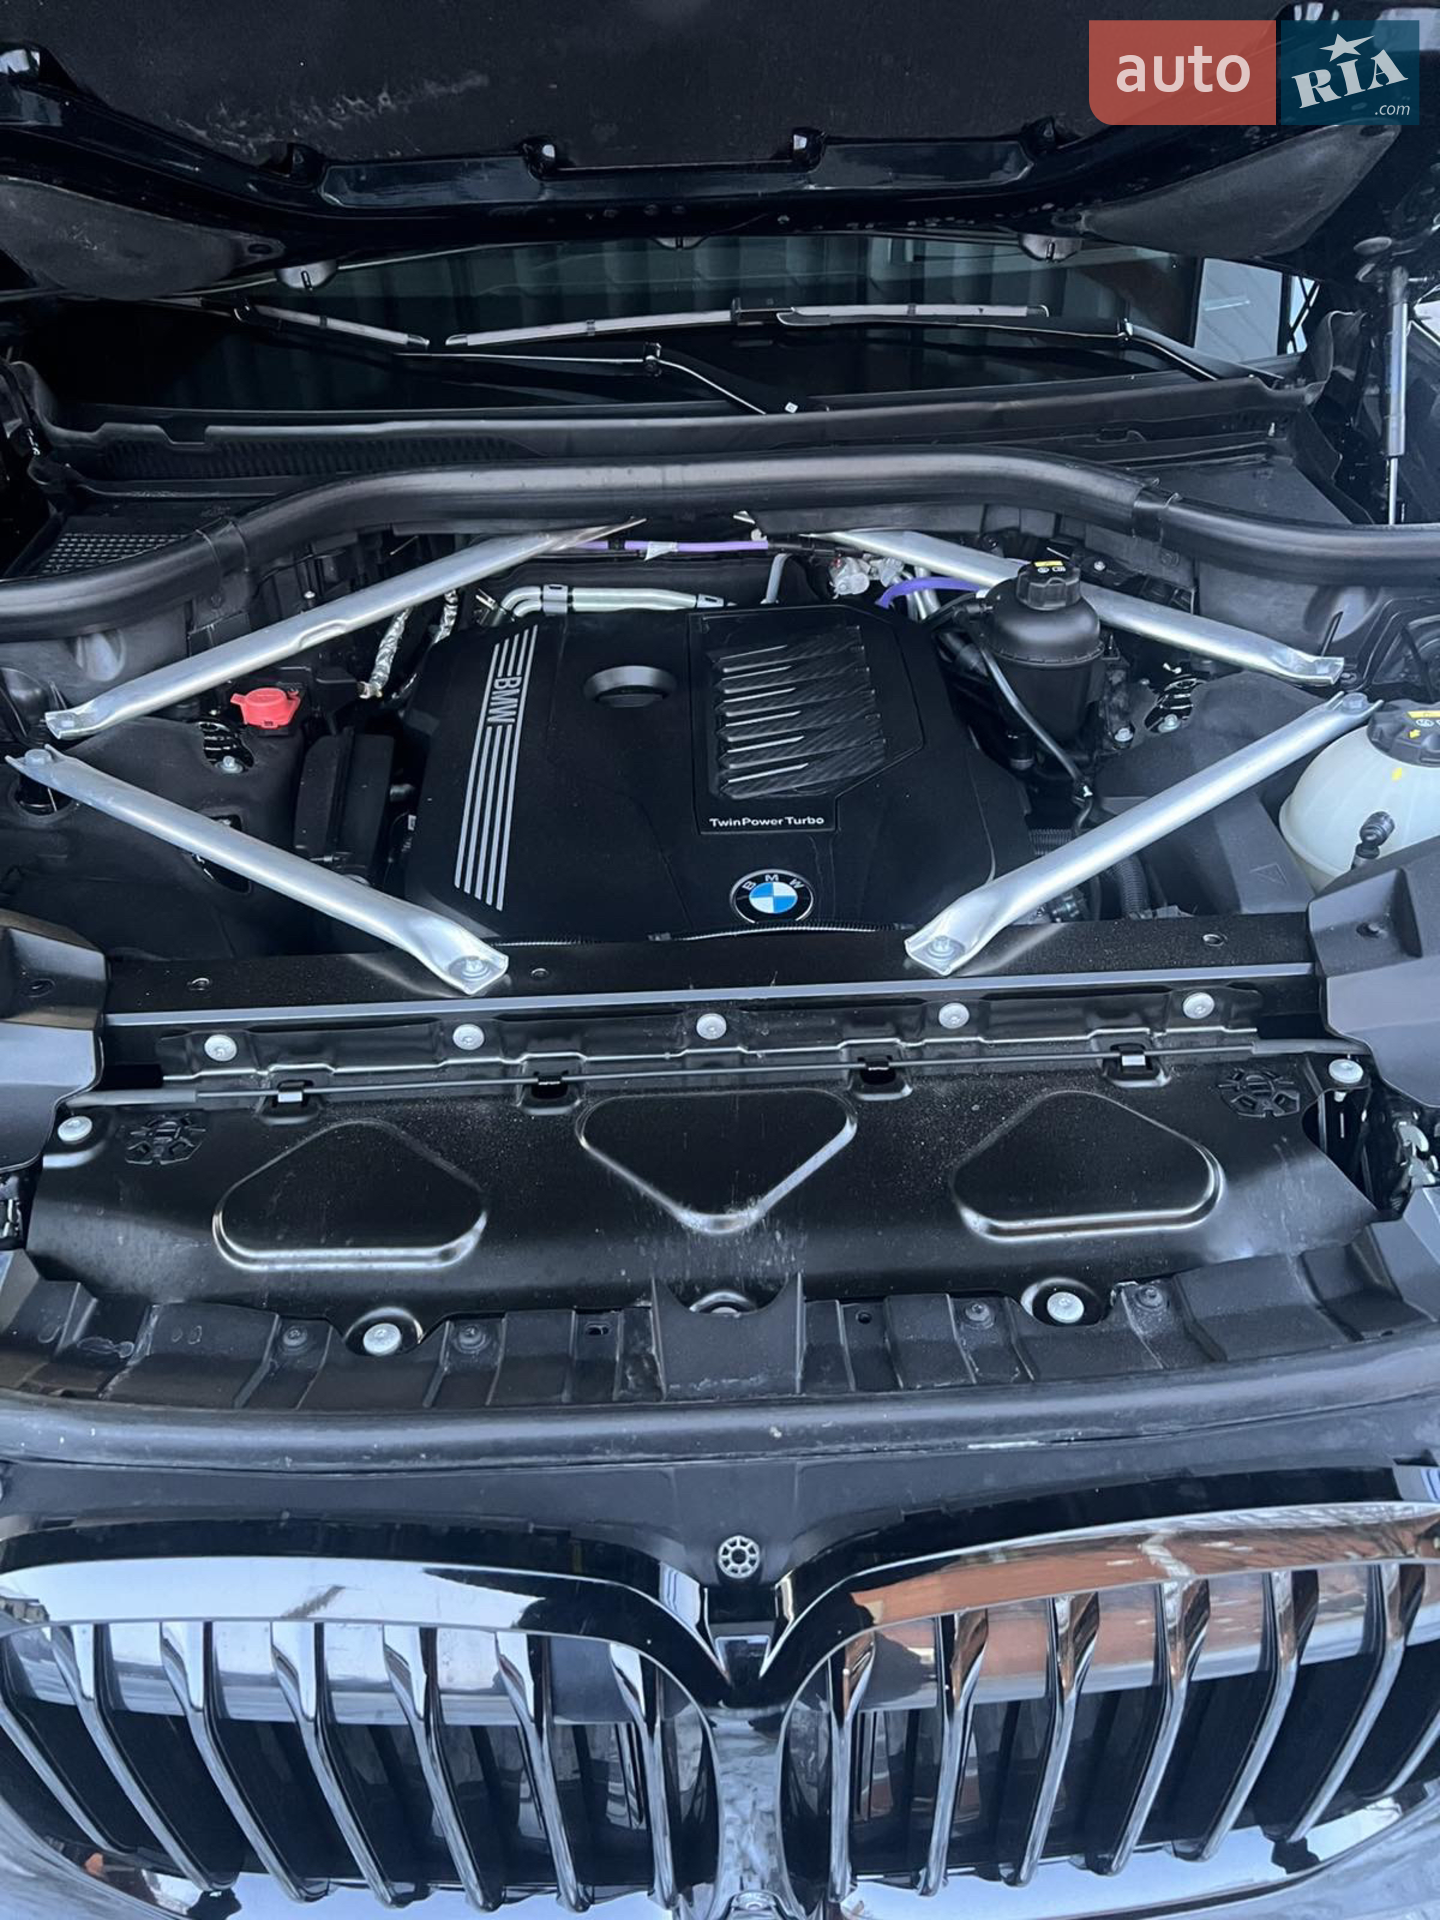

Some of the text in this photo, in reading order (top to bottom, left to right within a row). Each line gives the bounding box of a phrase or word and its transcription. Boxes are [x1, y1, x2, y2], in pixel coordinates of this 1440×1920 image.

[487, 676, 522, 723] BMW
[709, 816, 825, 827] TwinPower Turbo
[742, 874, 805, 890] BMW
